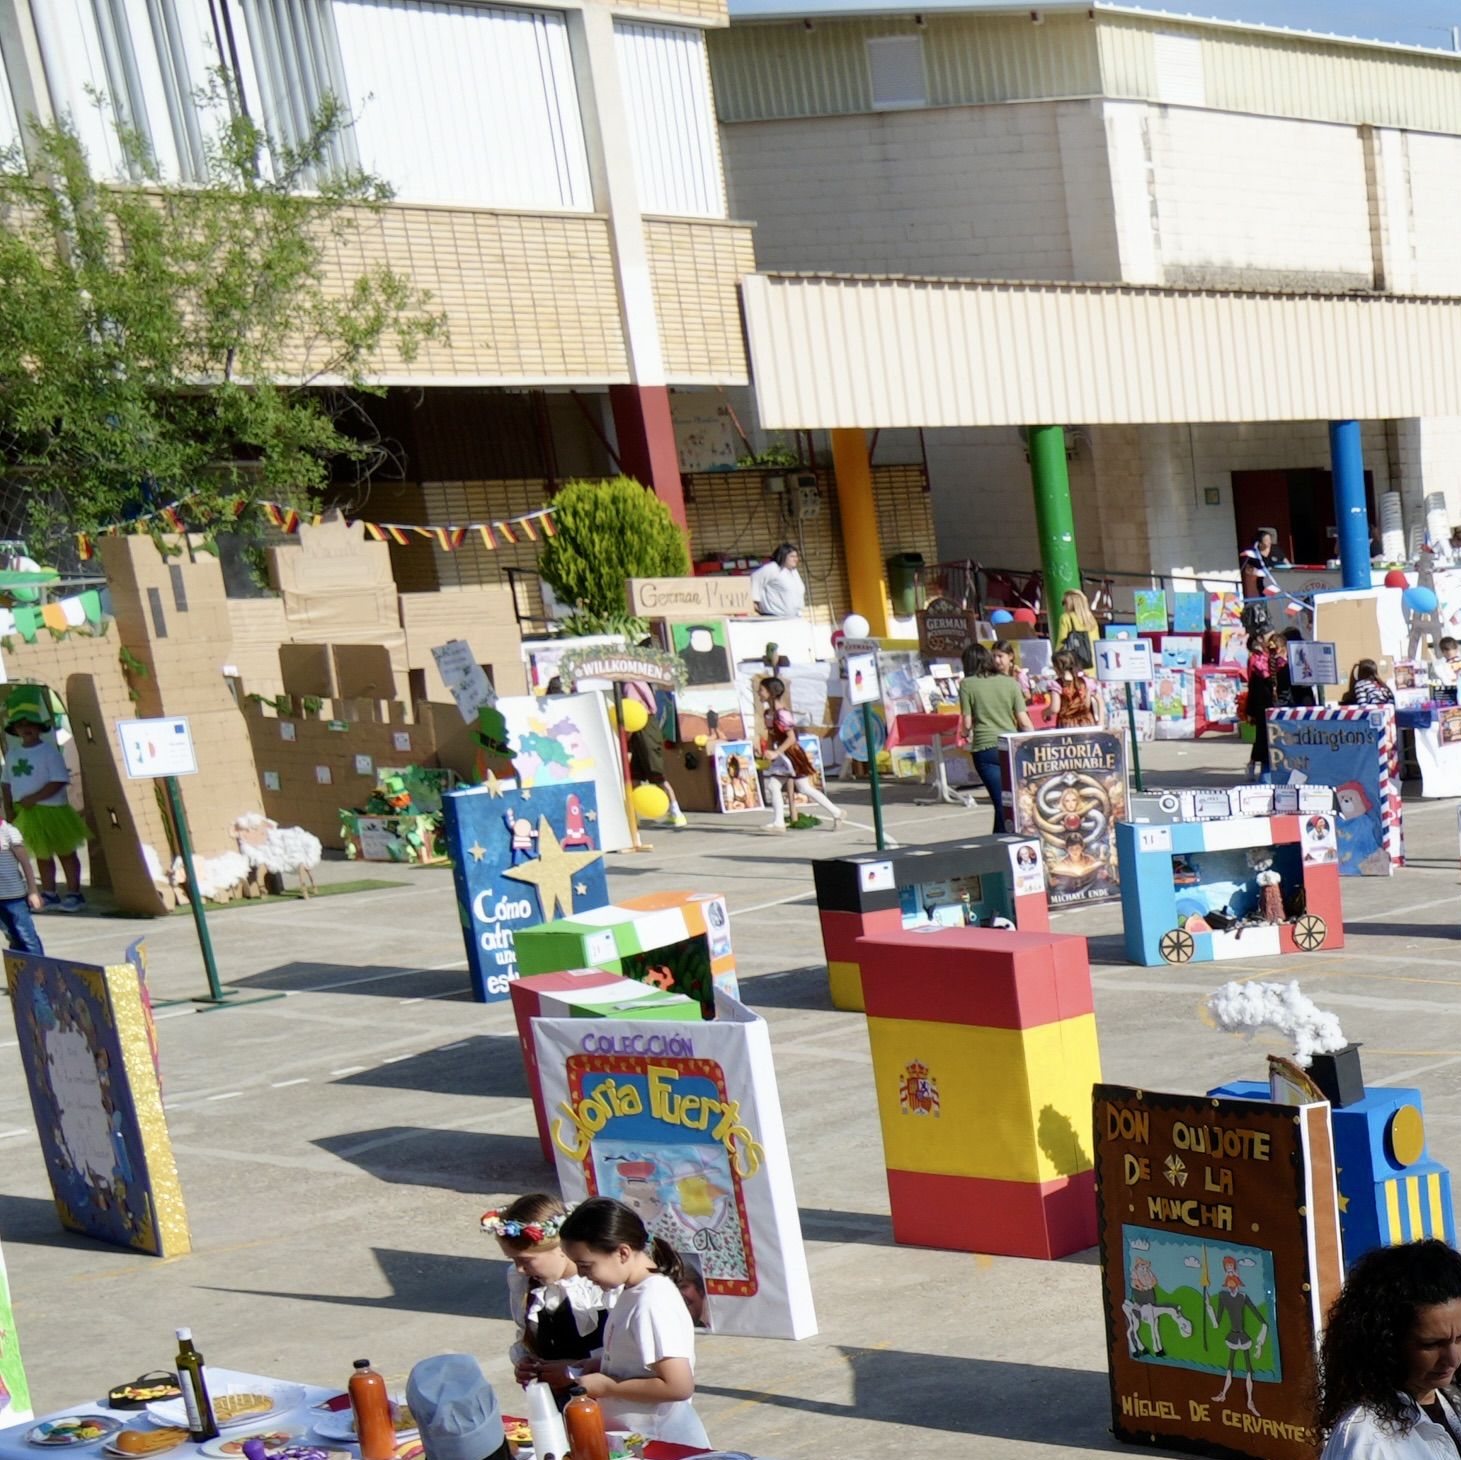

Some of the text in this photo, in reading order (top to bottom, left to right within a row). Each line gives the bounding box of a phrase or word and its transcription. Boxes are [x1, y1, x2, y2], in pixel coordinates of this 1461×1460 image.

[639, 583, 702, 609] German
[926, 618, 967, 629] GERMAN
[582, 659, 664, 679] WILLKOMMEN
[1034, 743, 1103, 762] HISTORIA
[1062, 736, 1073, 746] LA
[1022, 754, 1116, 777] INTERMINABLE
[473, 889, 531, 924] Cómo
[1050, 887, 1110, 904] MICHAEL ENDE
[582, 1033, 695, 1057] COLECCIÓN
[551, 1065, 766, 1179] Gloria Fuertes
[1107, 1102, 1271, 1161] DON QUIJOTE
[1124, 1153, 1234, 1195] DE LA
[1147, 1196, 1233, 1232] MANCHA
[1121, 1391, 1181, 1420] MIGUEL
[1188, 1399, 1211, 1422] DE
